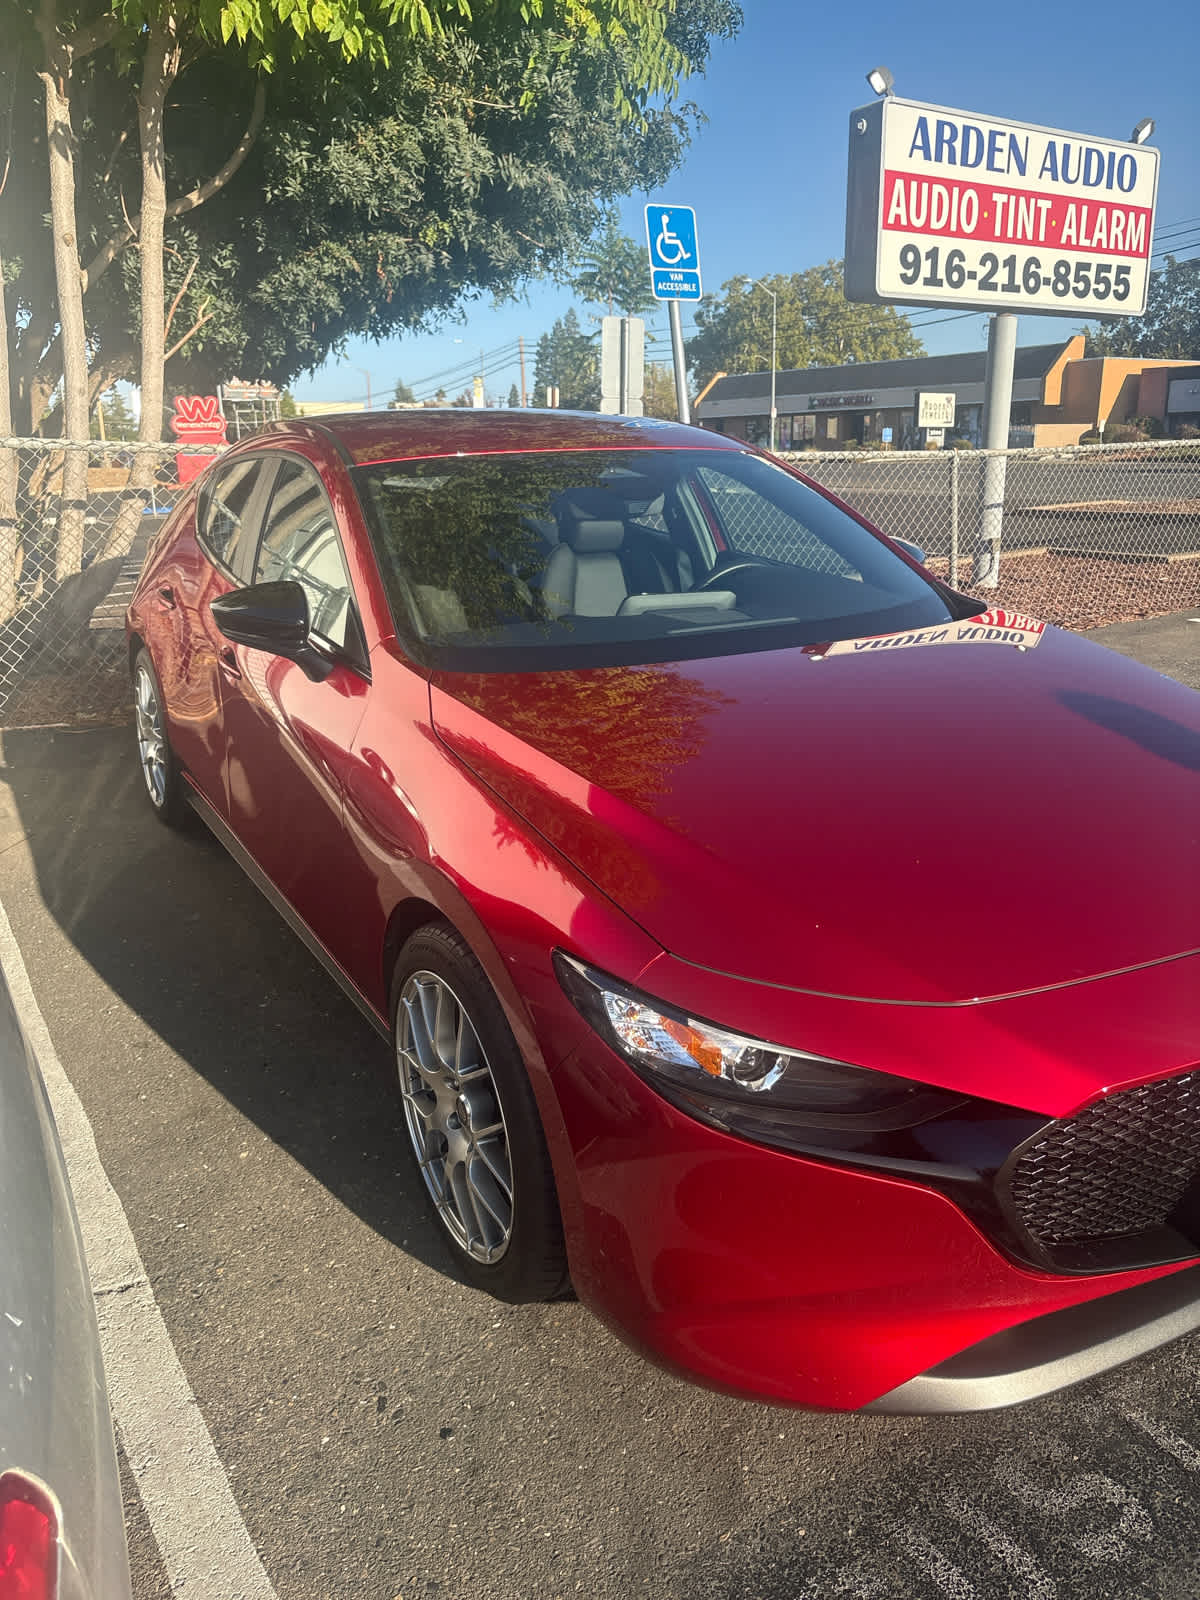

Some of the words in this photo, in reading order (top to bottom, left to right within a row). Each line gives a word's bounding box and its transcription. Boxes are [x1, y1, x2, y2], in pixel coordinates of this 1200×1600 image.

[909, 115, 1029, 176] ARDEN
[1038, 140, 1138, 193] AUDIO
[887, 178, 979, 234] AUDIO
[992, 192, 1053, 242] TINT
[1060, 203, 1147, 254] ALARM
[658, 282, 696, 291] ACCESSIBLE
[669, 273, 683, 281] VAN
[899, 243, 1132, 301] 916-216-8555
